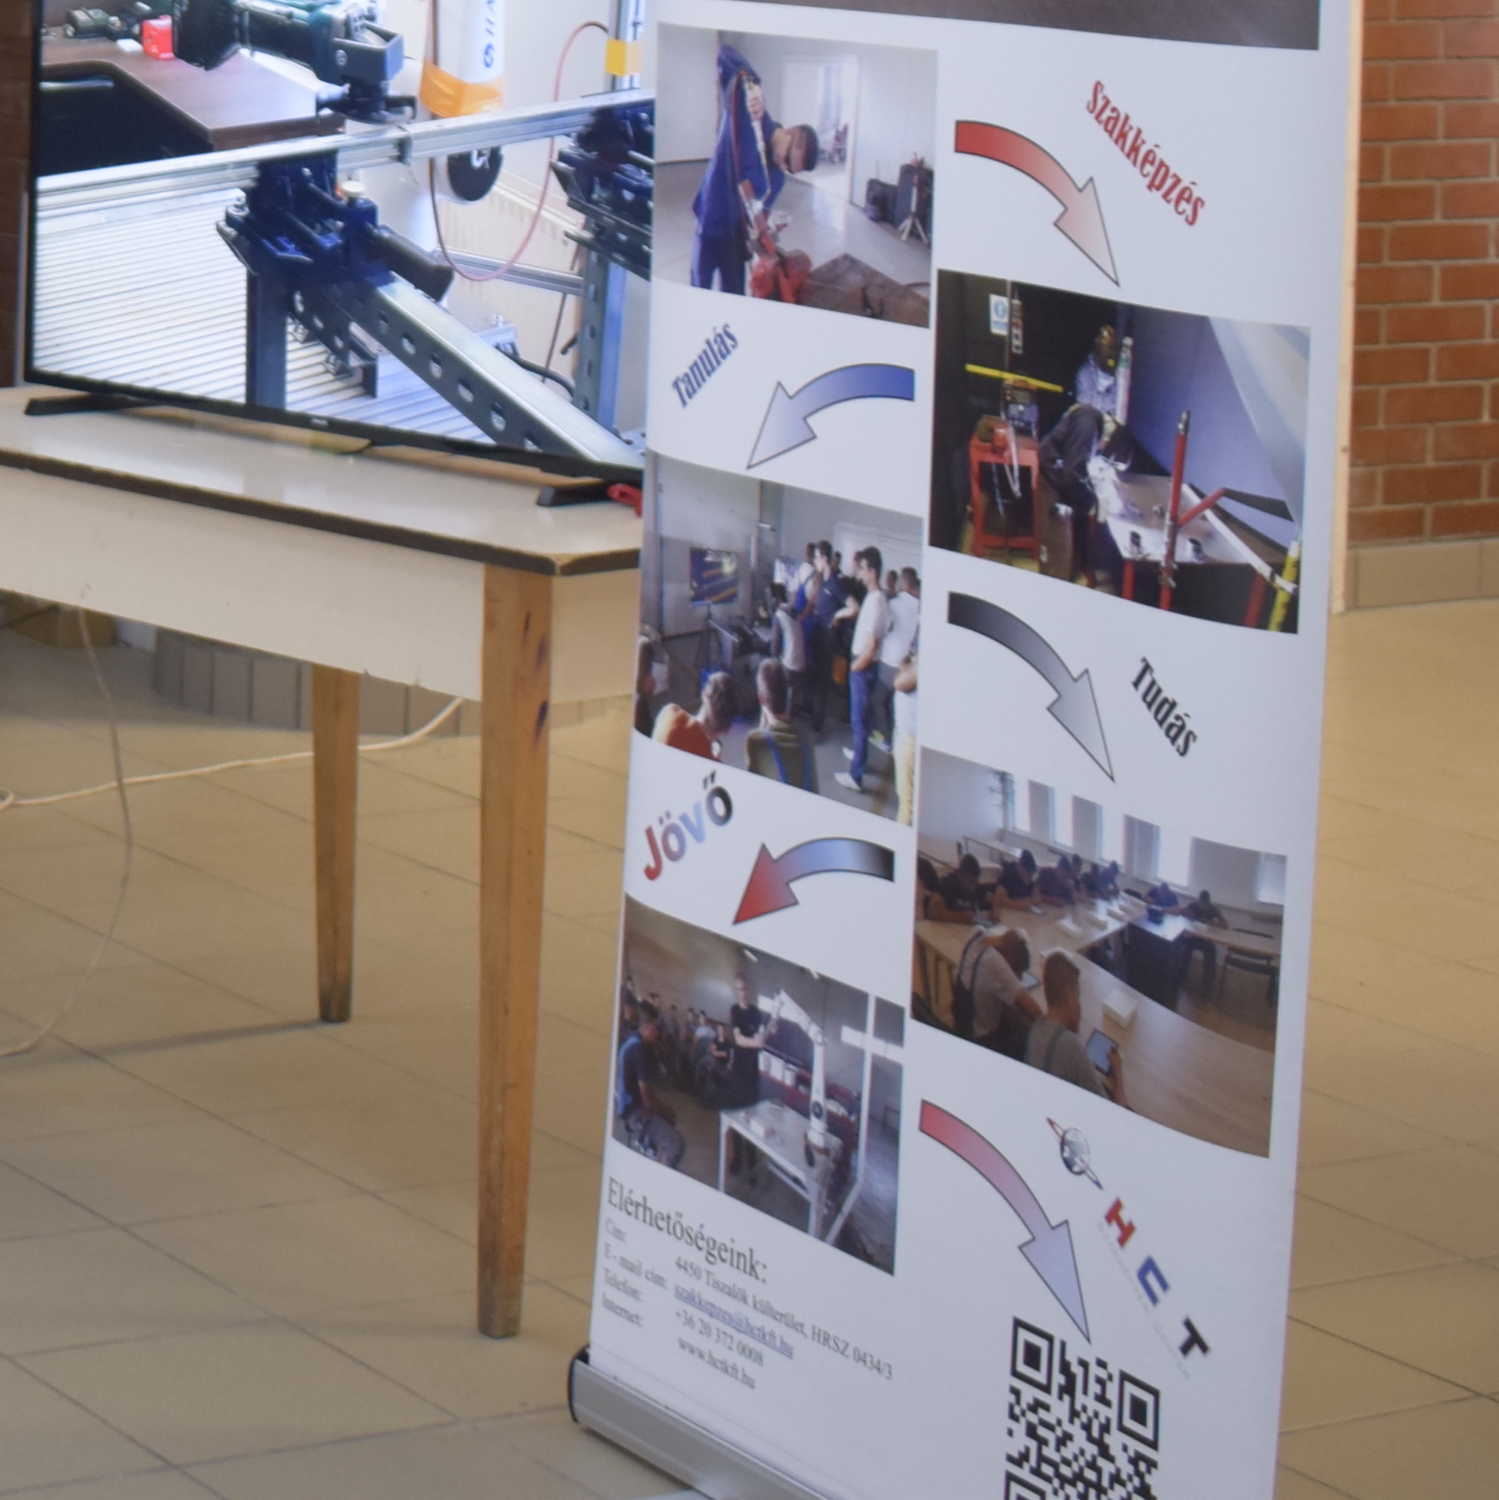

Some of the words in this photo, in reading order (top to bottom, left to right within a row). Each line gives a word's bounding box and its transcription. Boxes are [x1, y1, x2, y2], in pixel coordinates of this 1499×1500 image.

[1086, 80, 1205, 227] Szakképzés
[672, 323, 738, 408] Tanulás
[1131, 656, 1197, 757] Tudás
[644, 770, 733, 881] Jövő
[607, 1176, 767, 1283] Elérhetőségeink:
[1104, 1197, 1209, 1358] HCT
[675, 1256, 702, 1281] 4450
[811, 1324, 850, 1359] HRSZ
[853, 1346, 893, 1380] 0434/3
